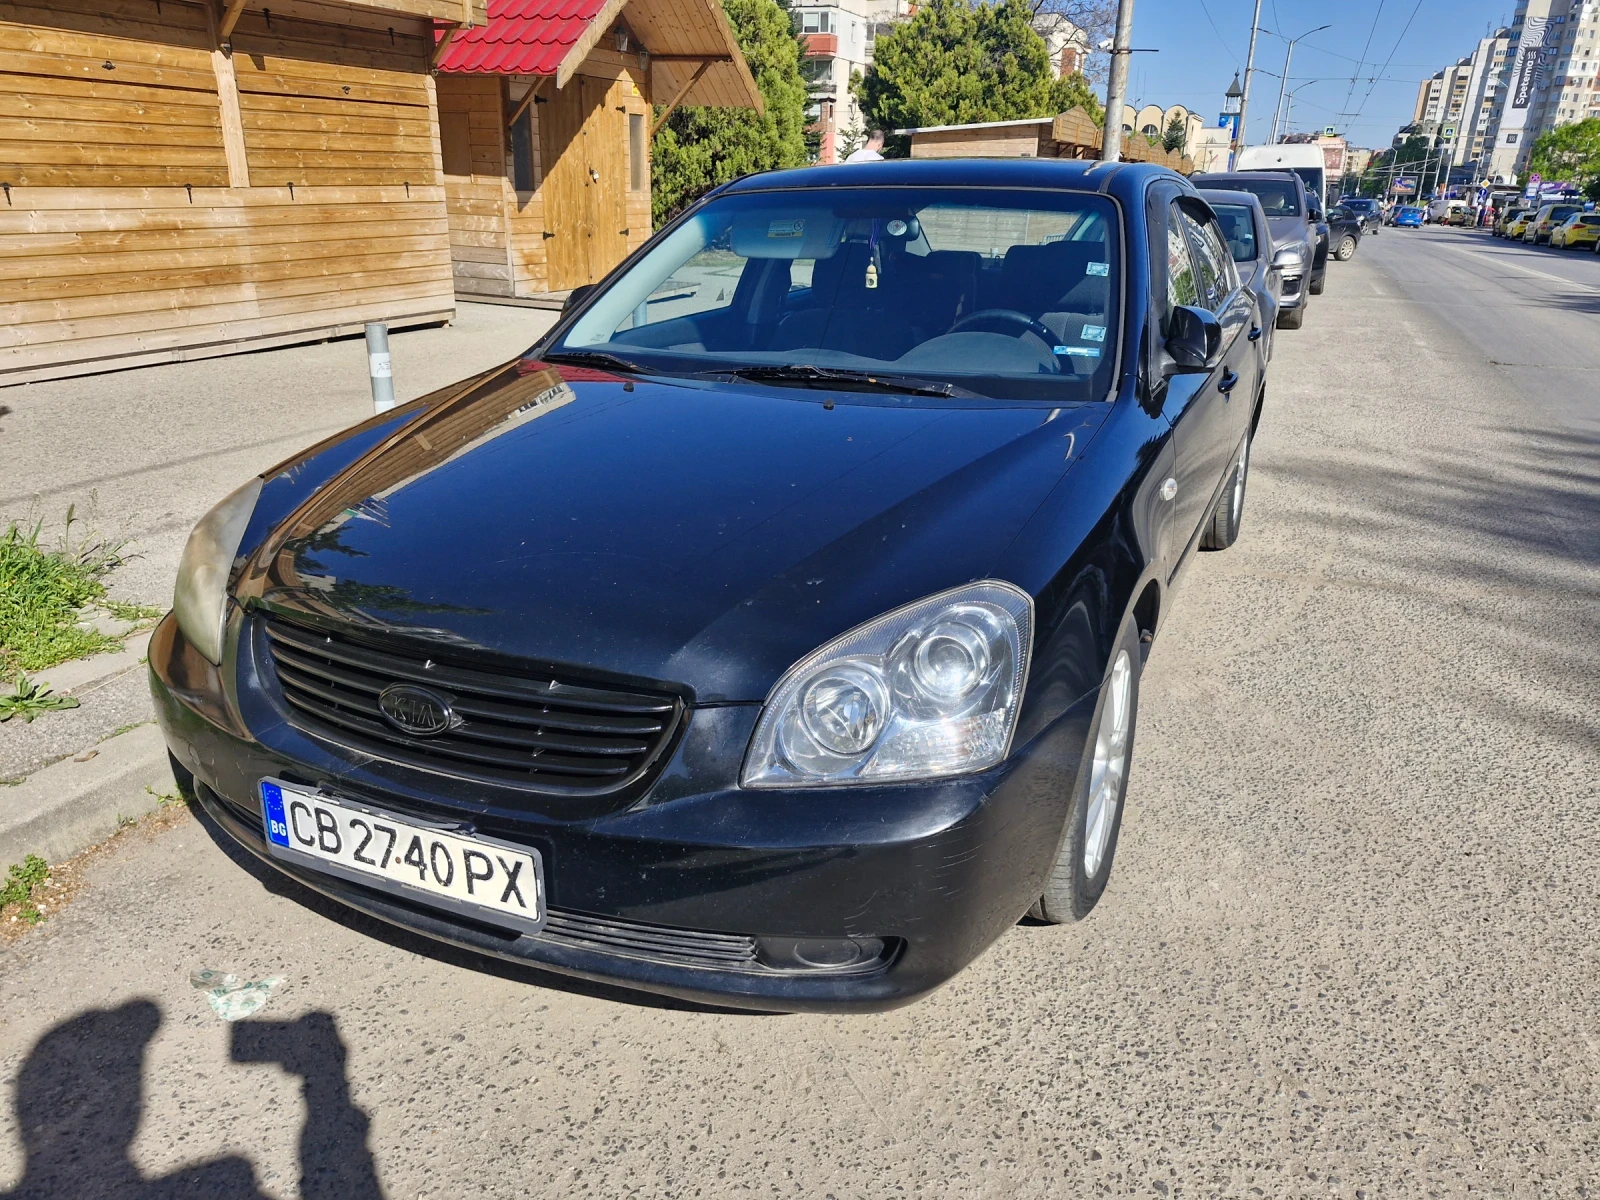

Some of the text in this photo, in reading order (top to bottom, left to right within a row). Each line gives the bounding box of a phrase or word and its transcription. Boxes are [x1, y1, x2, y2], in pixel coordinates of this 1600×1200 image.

[1516, 60, 1534, 104] Spetema
[392, 695, 436, 727] KIA
[270, 819, 287, 837] BG
[289, 800, 527, 908] CB 2740 PX
